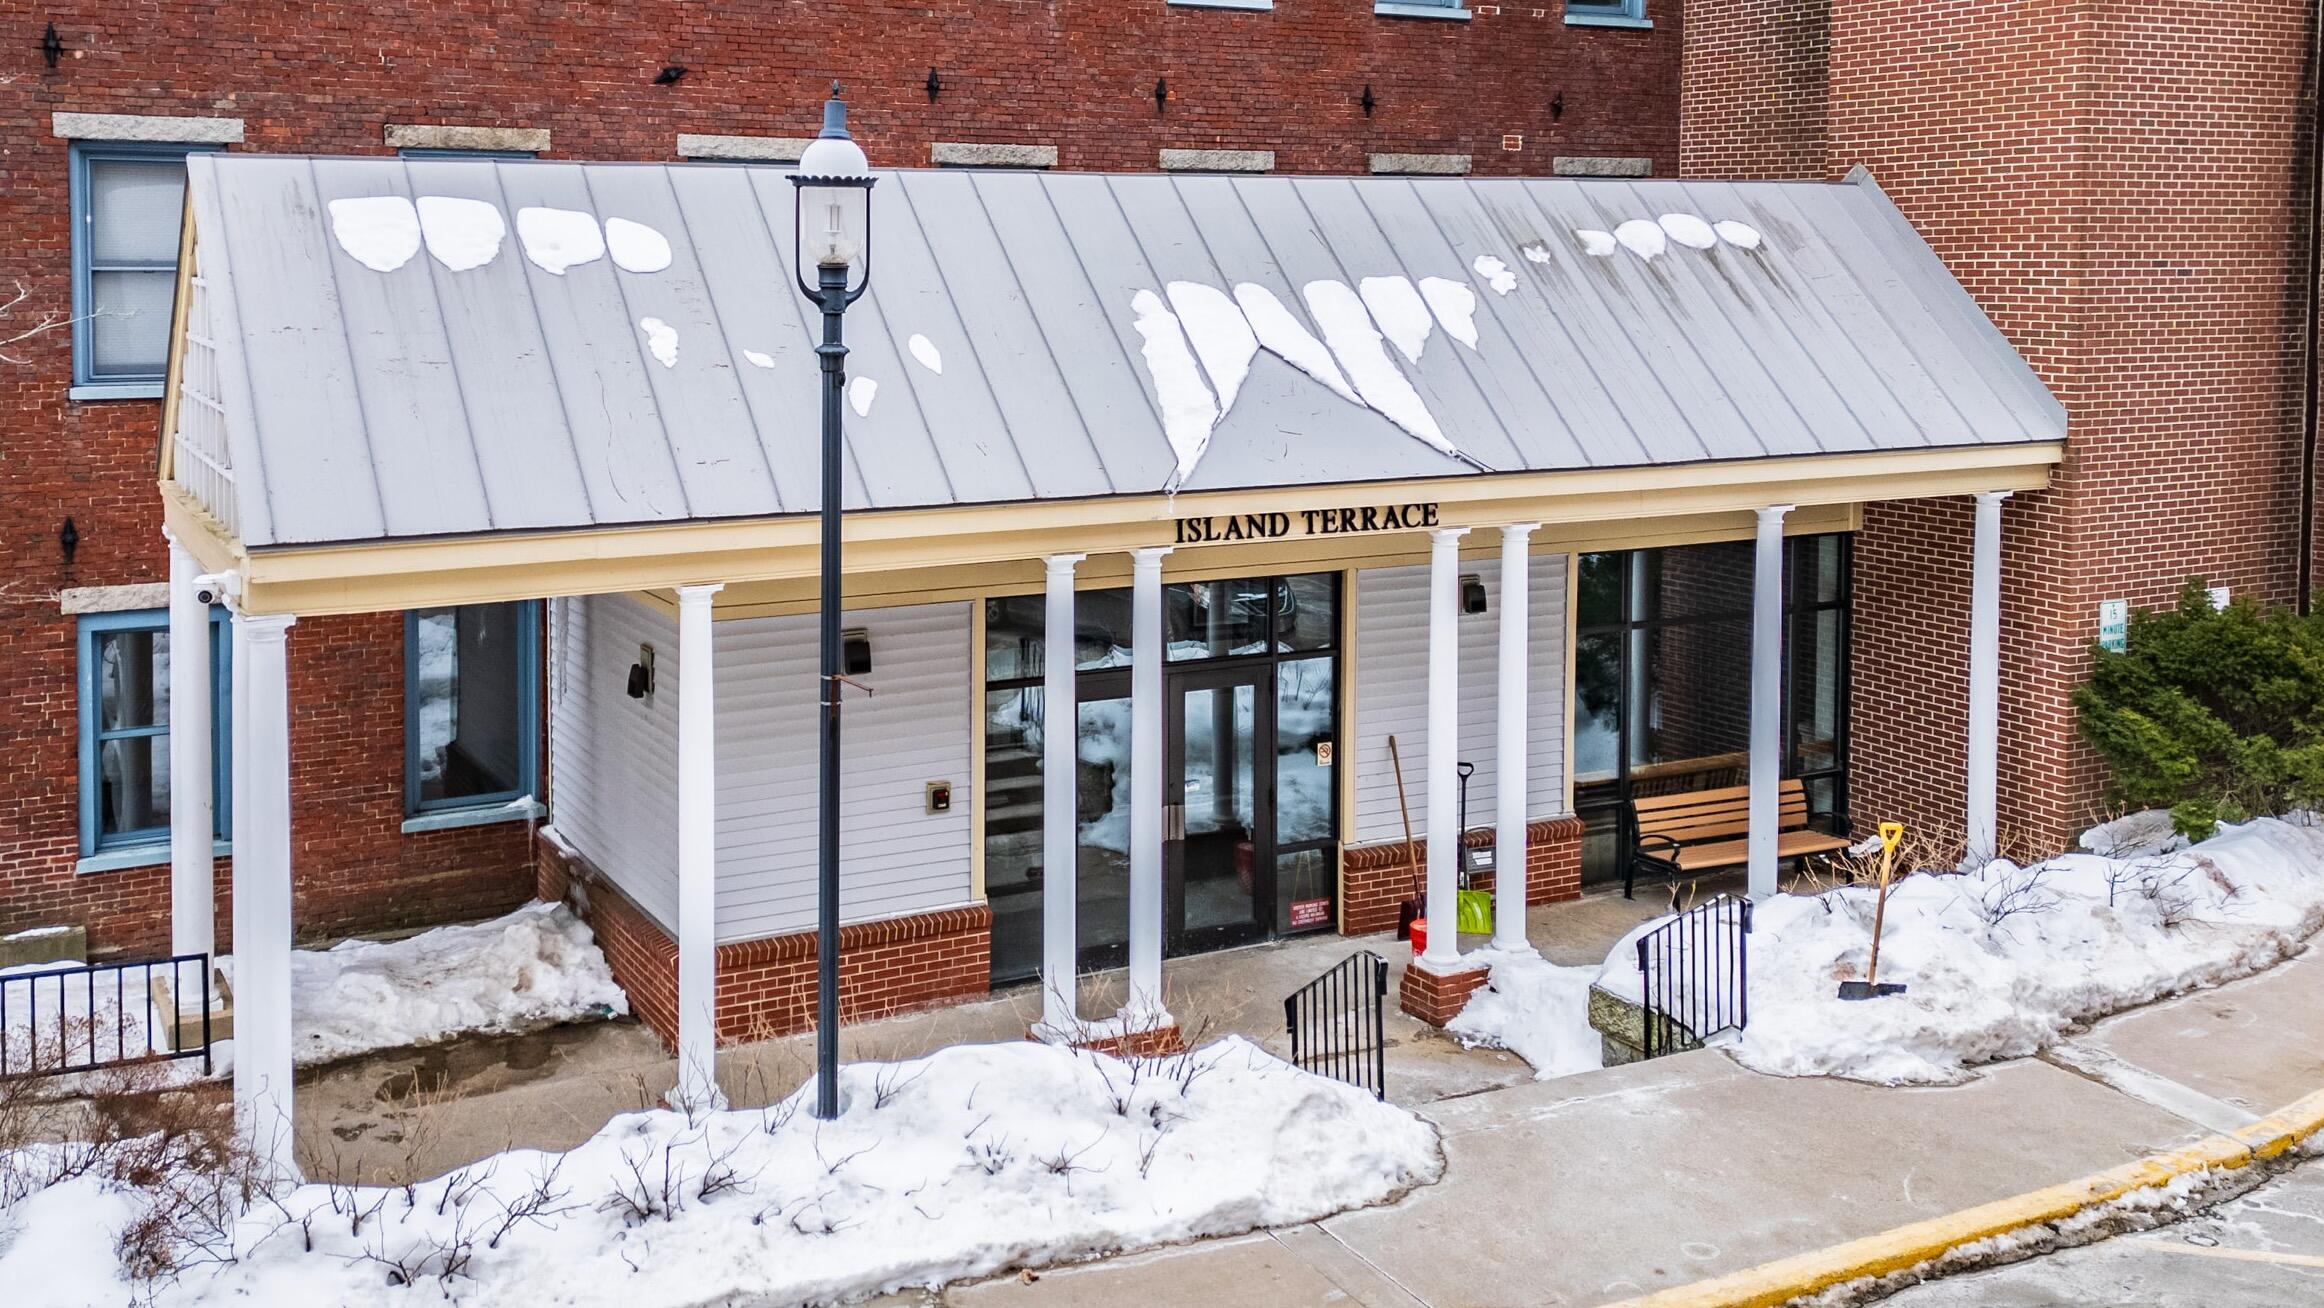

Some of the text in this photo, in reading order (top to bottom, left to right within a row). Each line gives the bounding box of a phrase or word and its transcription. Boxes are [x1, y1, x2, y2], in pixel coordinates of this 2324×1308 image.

[1175, 503, 1439, 543] ISLAND TERRACE
[2110, 608, 2118, 620] 15
[2102, 623, 2124, 635] MINUTE
